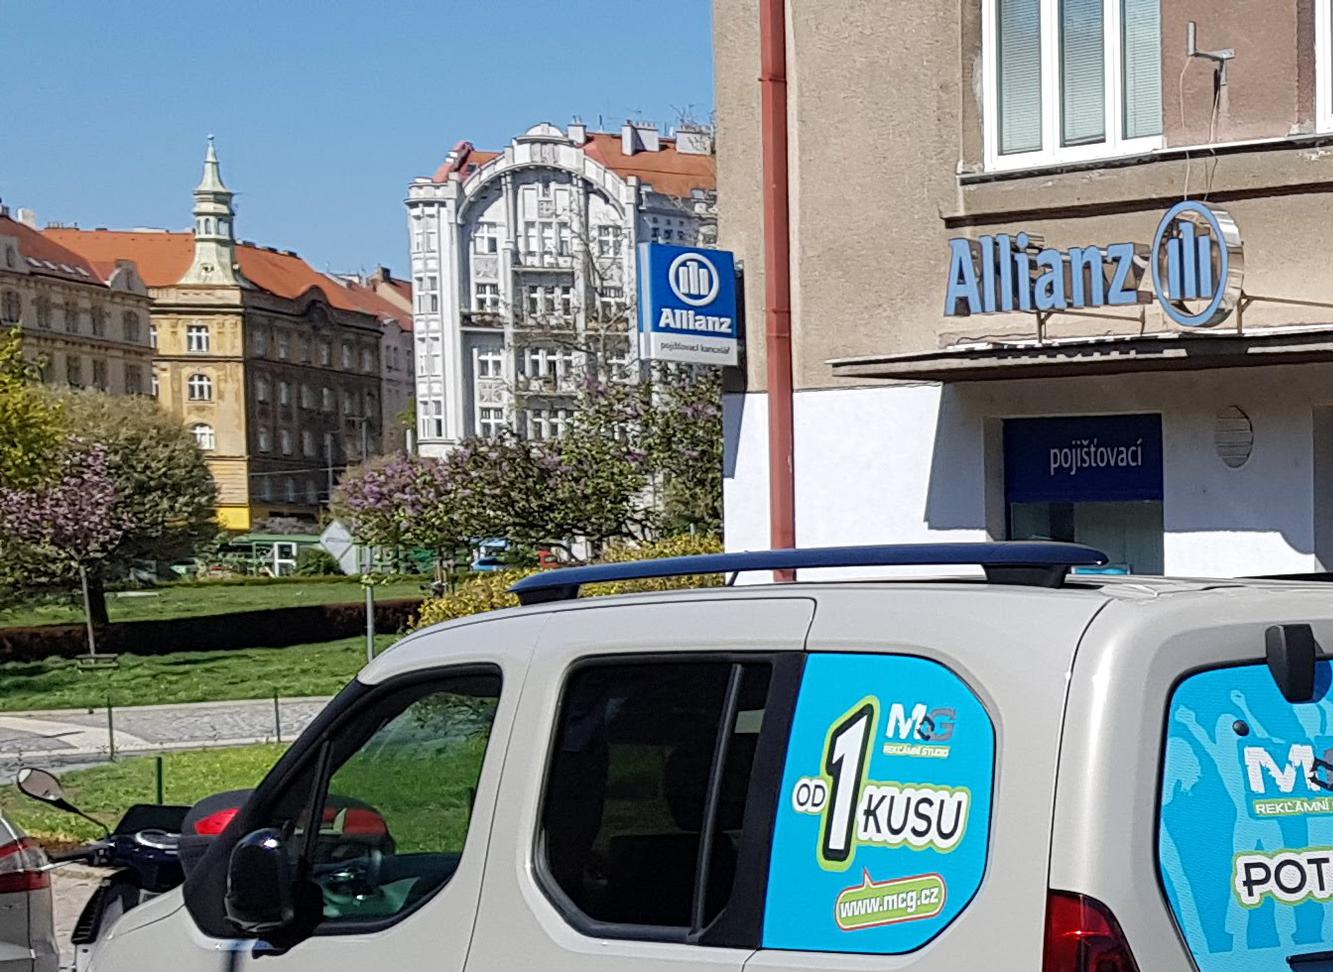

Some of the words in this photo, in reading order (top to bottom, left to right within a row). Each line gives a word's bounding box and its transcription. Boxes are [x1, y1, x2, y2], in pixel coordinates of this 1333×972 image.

[944, 232, 1139, 316] Allianz
[659, 308, 732, 333] Allianz
[1050, 438, 1143, 475] pojišťovací
[796, 783, 826, 808] OD
[822, 703, 874, 862] 1
[863, 793, 963, 841] KUSU
[839, 886, 940, 919] www.mcg.cz
